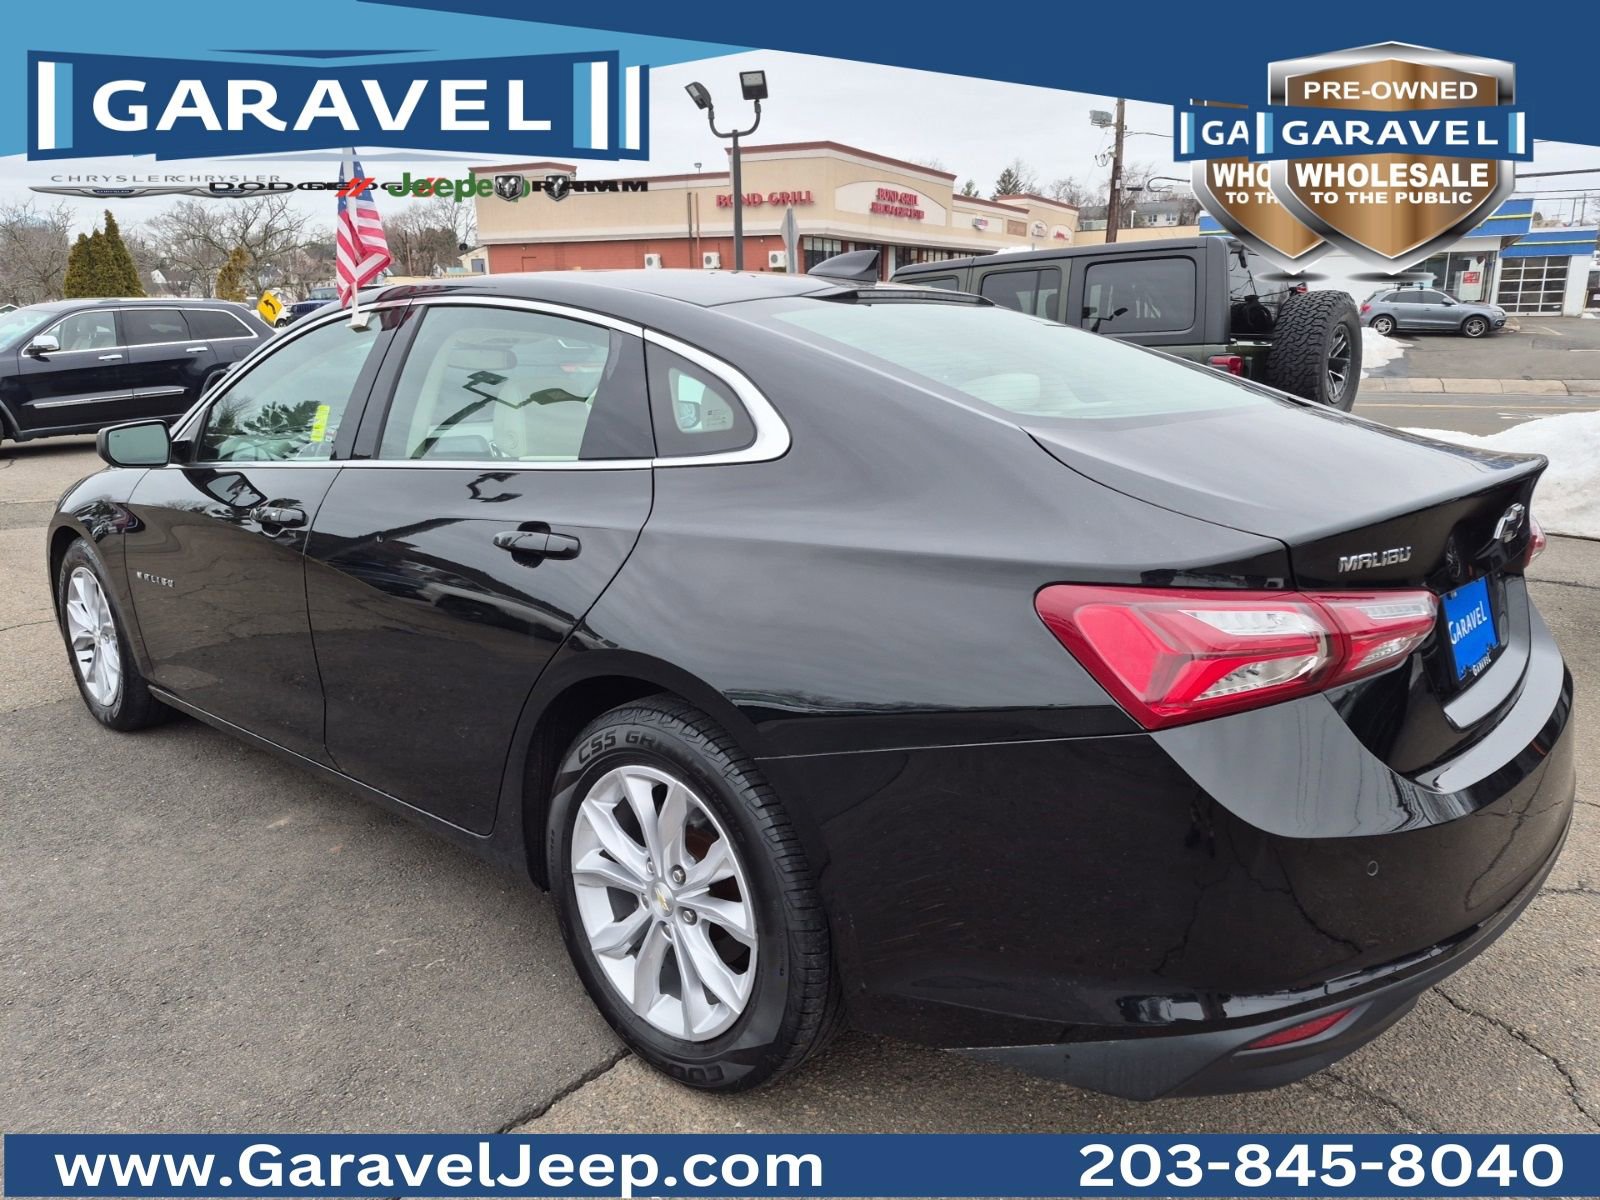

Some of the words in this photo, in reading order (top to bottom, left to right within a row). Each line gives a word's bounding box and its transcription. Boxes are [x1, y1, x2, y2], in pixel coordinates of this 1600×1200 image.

[767, 190, 815, 206] GRILL
[1338, 545, 1412, 573] MALIBU
[1449, 600, 1488, 645] GARAVEL
